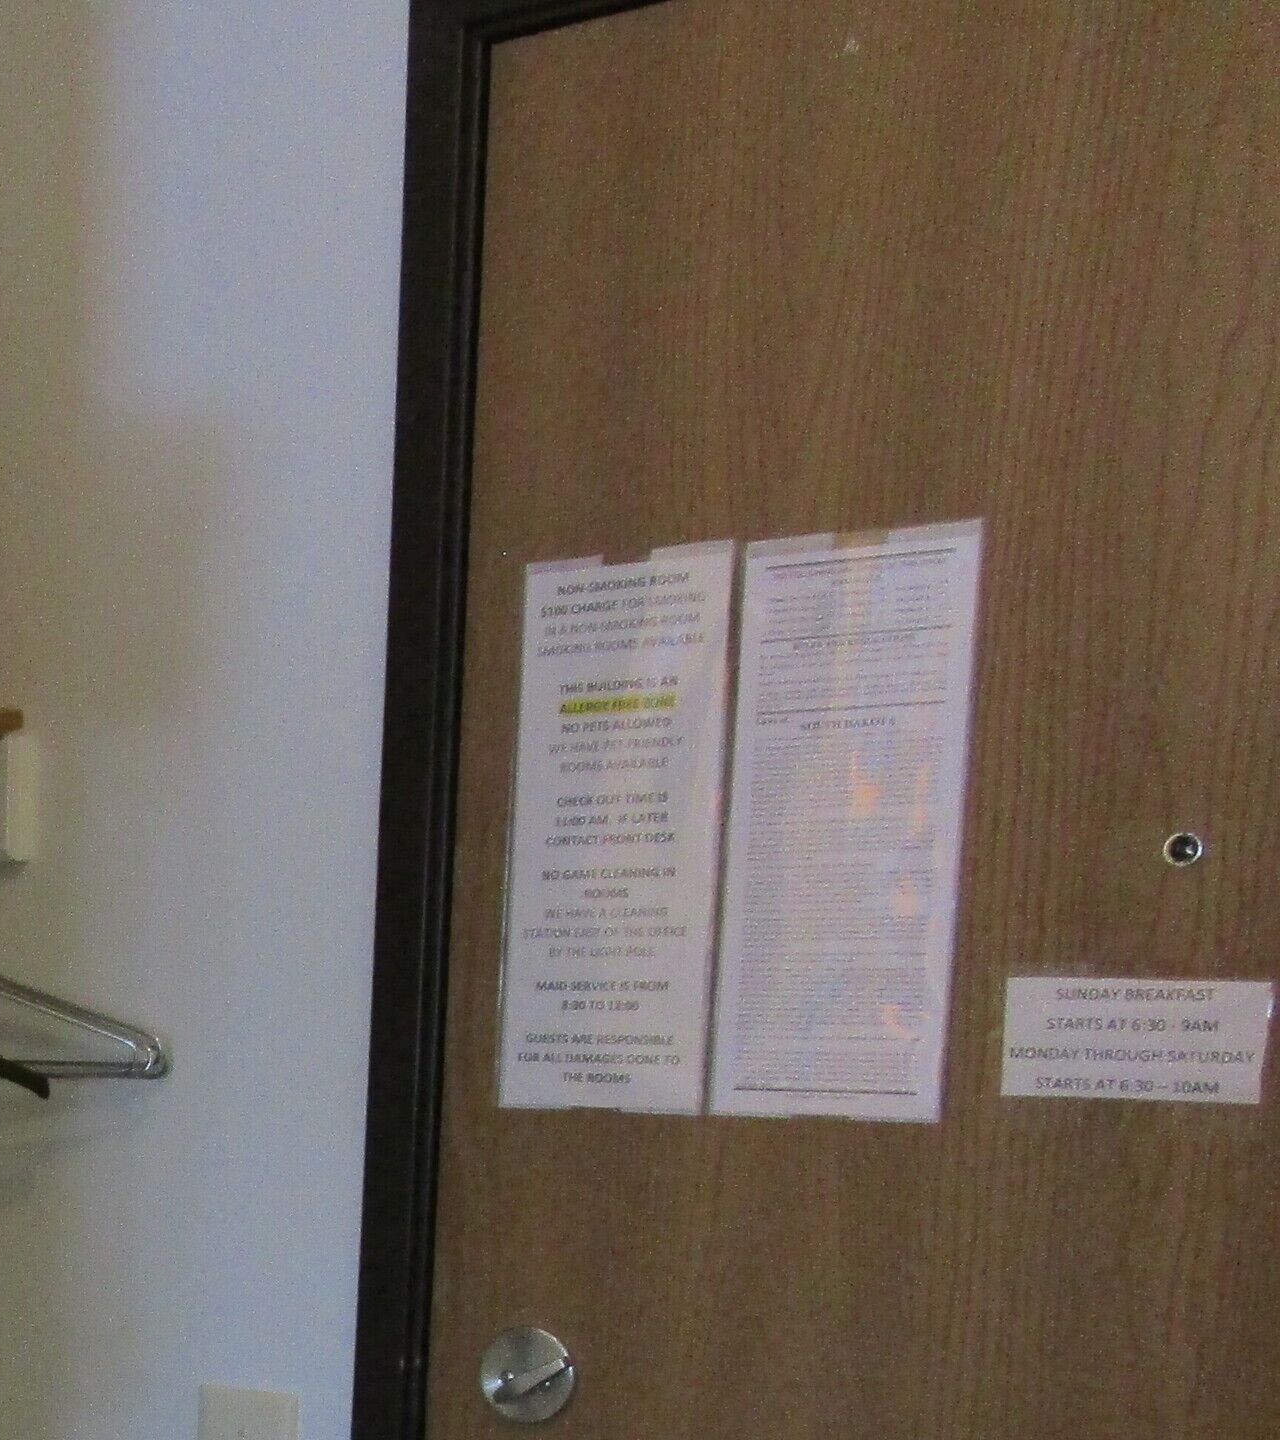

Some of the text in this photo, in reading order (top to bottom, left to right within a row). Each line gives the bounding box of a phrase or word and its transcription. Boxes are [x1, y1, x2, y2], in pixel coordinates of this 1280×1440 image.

[649, 572, 689, 587] ROOM
[571, 600, 618, 615] CHARGE
[557, 794, 593, 807] CHECK
[545, 834, 599, 847] CONTACT
[536, 980, 568, 991] MAID
[570, 980, 617, 992] SERVICE
[633, 980, 669, 992] FROM
[1056, 987, 1216, 1002] SUNDAY BREAKFAST
[1046, 1017, 1104, 1031] STARTS
[1106, 1018, 1127, 1031] AT
[1181, 1017, 1220, 1033] 9AM
[526, 1032, 674, 1046] GUESTS ARE RESPONSIBLE
[1010, 1047, 1255, 1064] MONDAY THROUGH SATURDAY
[1035, 1076, 1091, 1091] STARTS
[1094, 1078, 1116, 1091] AT
